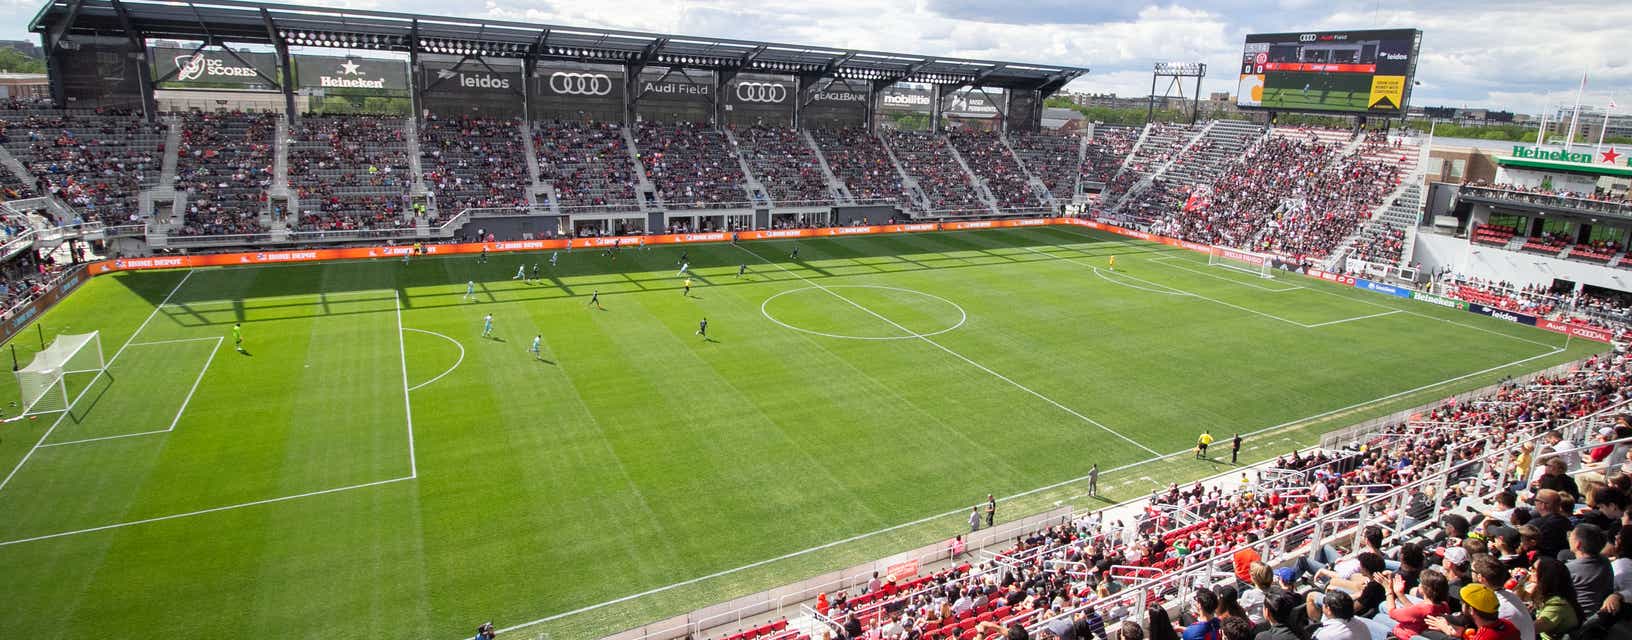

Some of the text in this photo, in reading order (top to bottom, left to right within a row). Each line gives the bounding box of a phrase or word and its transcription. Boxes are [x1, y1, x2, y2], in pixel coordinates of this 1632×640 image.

[206, 59, 222, 67] DC
[207, 66, 258, 77] SCORES
[320, 76, 384, 88] Heineken
[460, 73, 510, 89] leidos
[644, 82, 708, 95] Audi Field
[1512, 145, 1592, 164] Heineken
[1491, 309, 1518, 322] leidos
[1546, 322, 1567, 333] Audi
